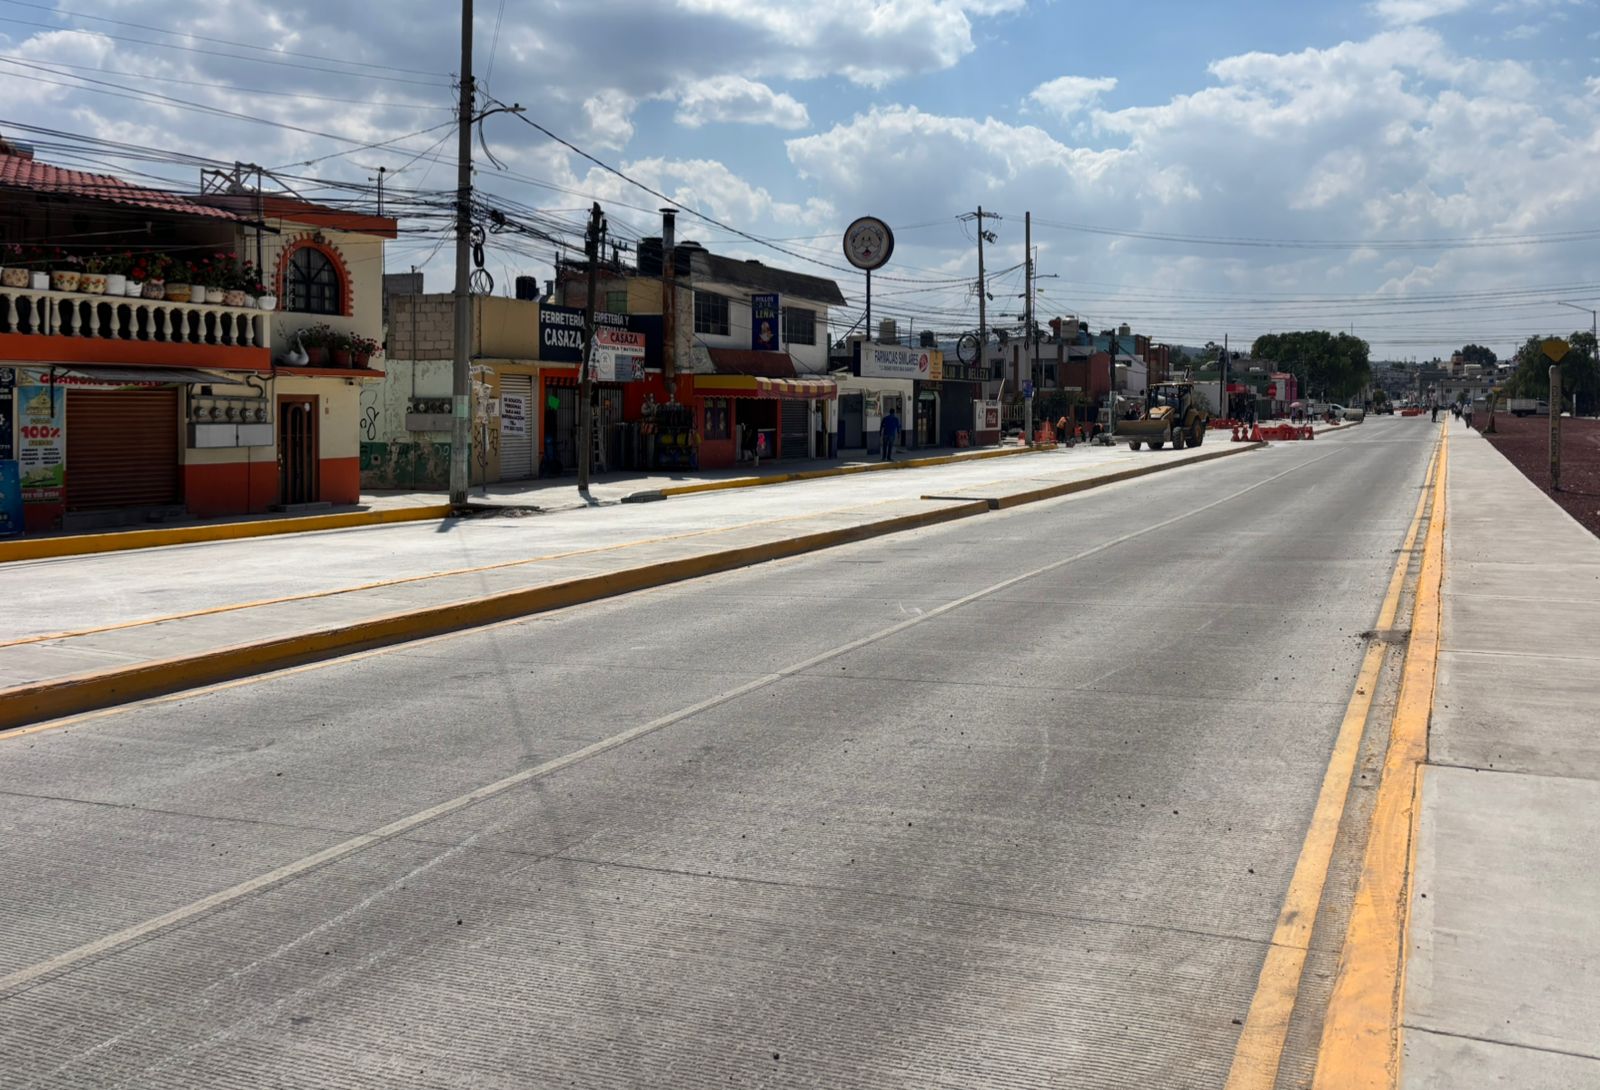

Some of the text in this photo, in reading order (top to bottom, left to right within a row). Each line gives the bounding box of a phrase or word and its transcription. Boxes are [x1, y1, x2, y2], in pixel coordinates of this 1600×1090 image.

[540, 310, 585, 329] FERRETERÍA
[545, 328, 583, 348] CASAZA
[611, 332, 639, 345] CASAZA
[875, 350, 898, 365] FARMACIAS
[899, 351, 919, 367] SIMILARES
[21, 426, 61, 439] 100%
